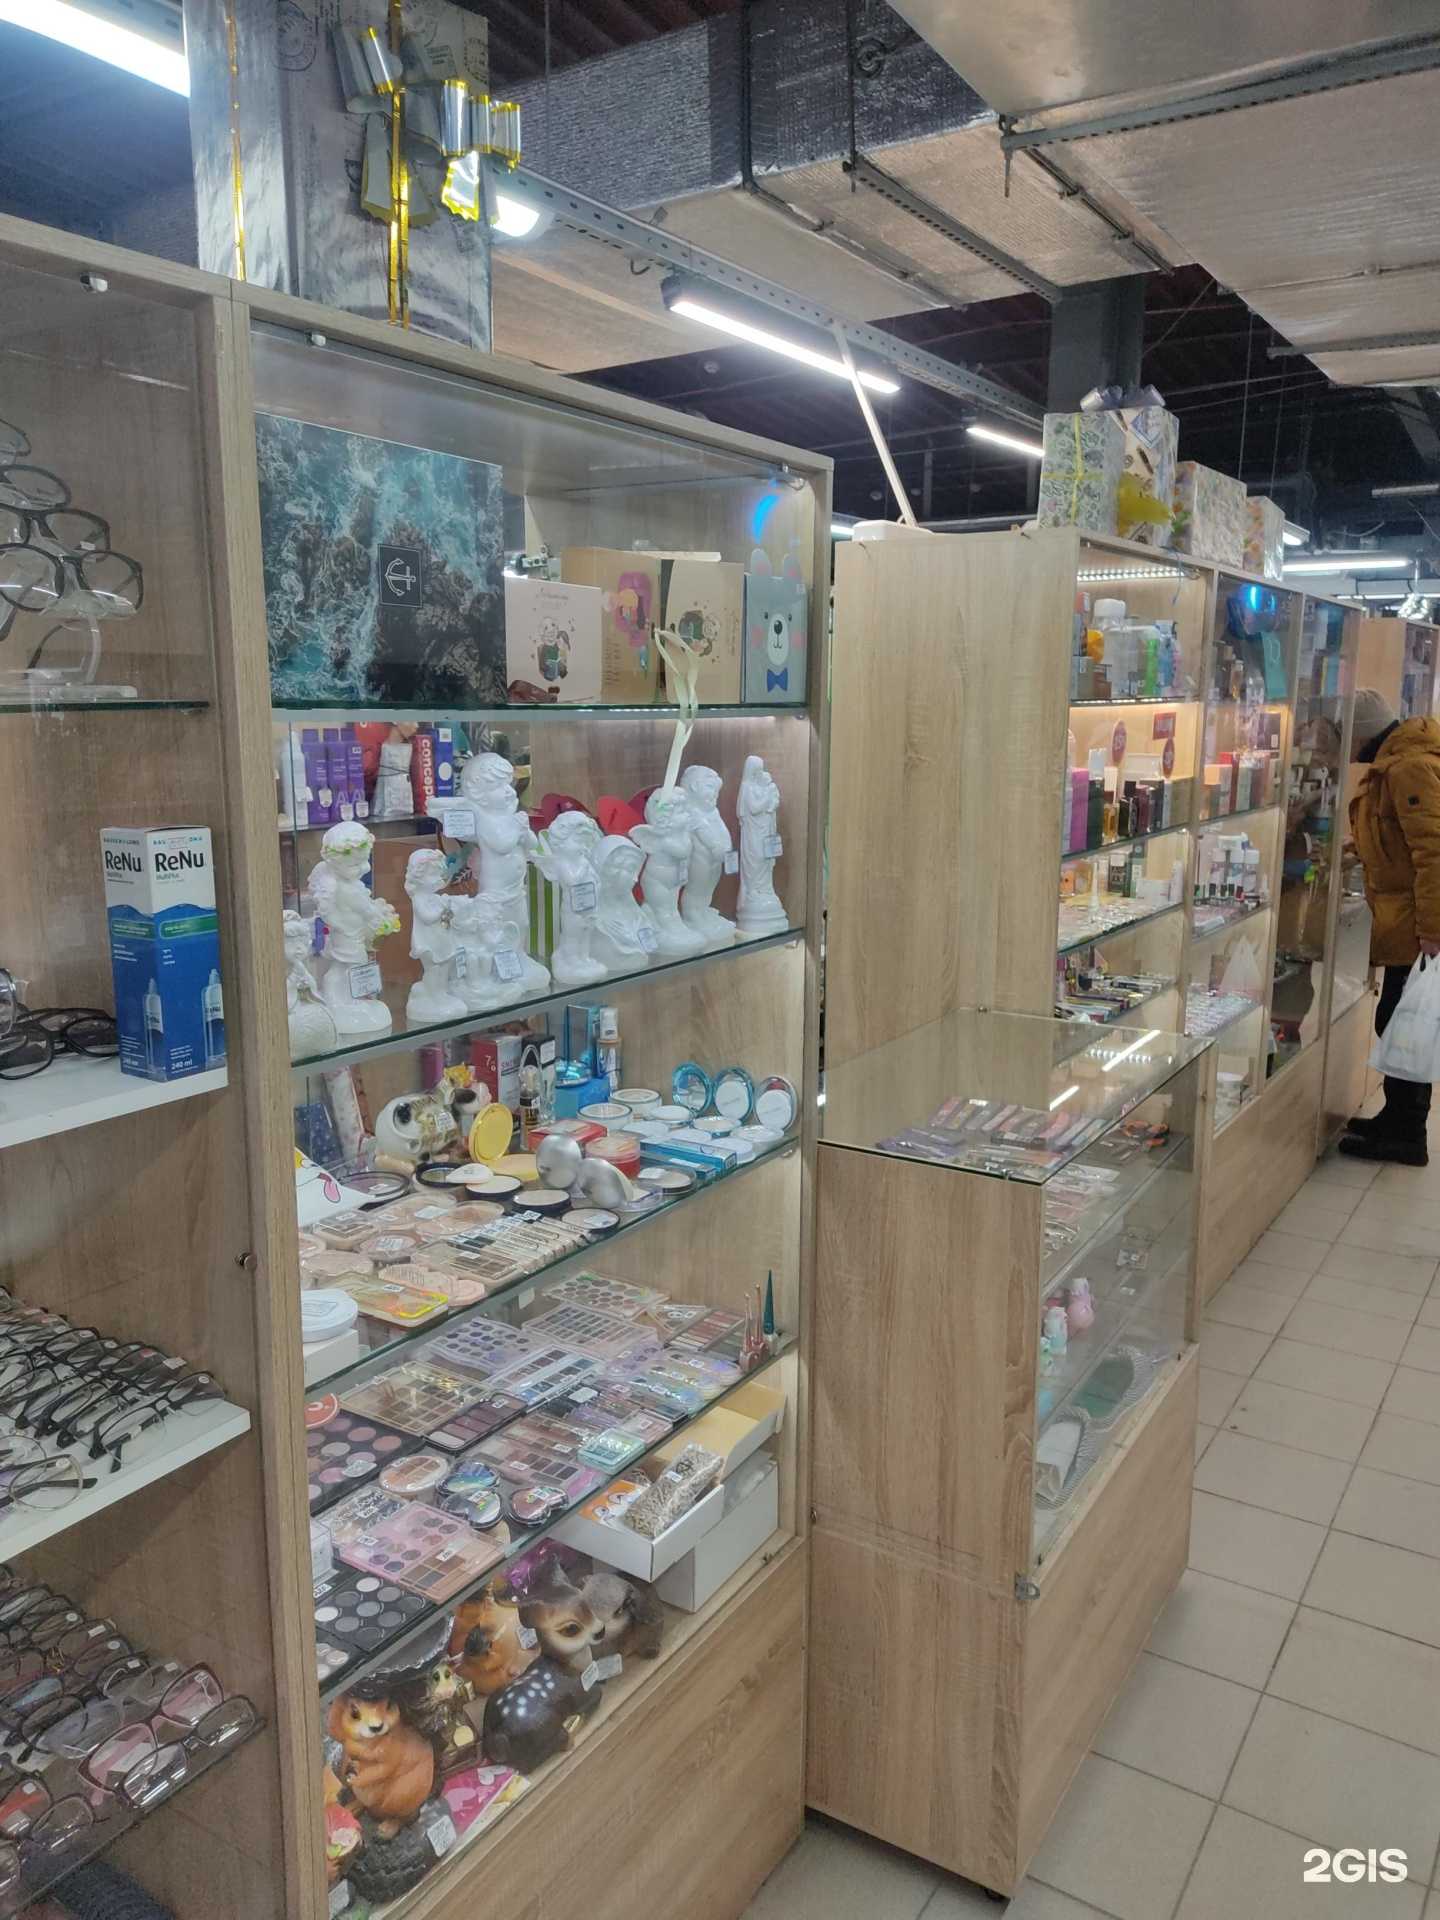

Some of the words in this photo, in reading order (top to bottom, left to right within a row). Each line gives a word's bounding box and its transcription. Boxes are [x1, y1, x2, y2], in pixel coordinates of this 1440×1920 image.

[422, 739, 436, 806] concep
[104, 850, 142, 873] ReNu
[154, 849, 204, 873] ReNu
